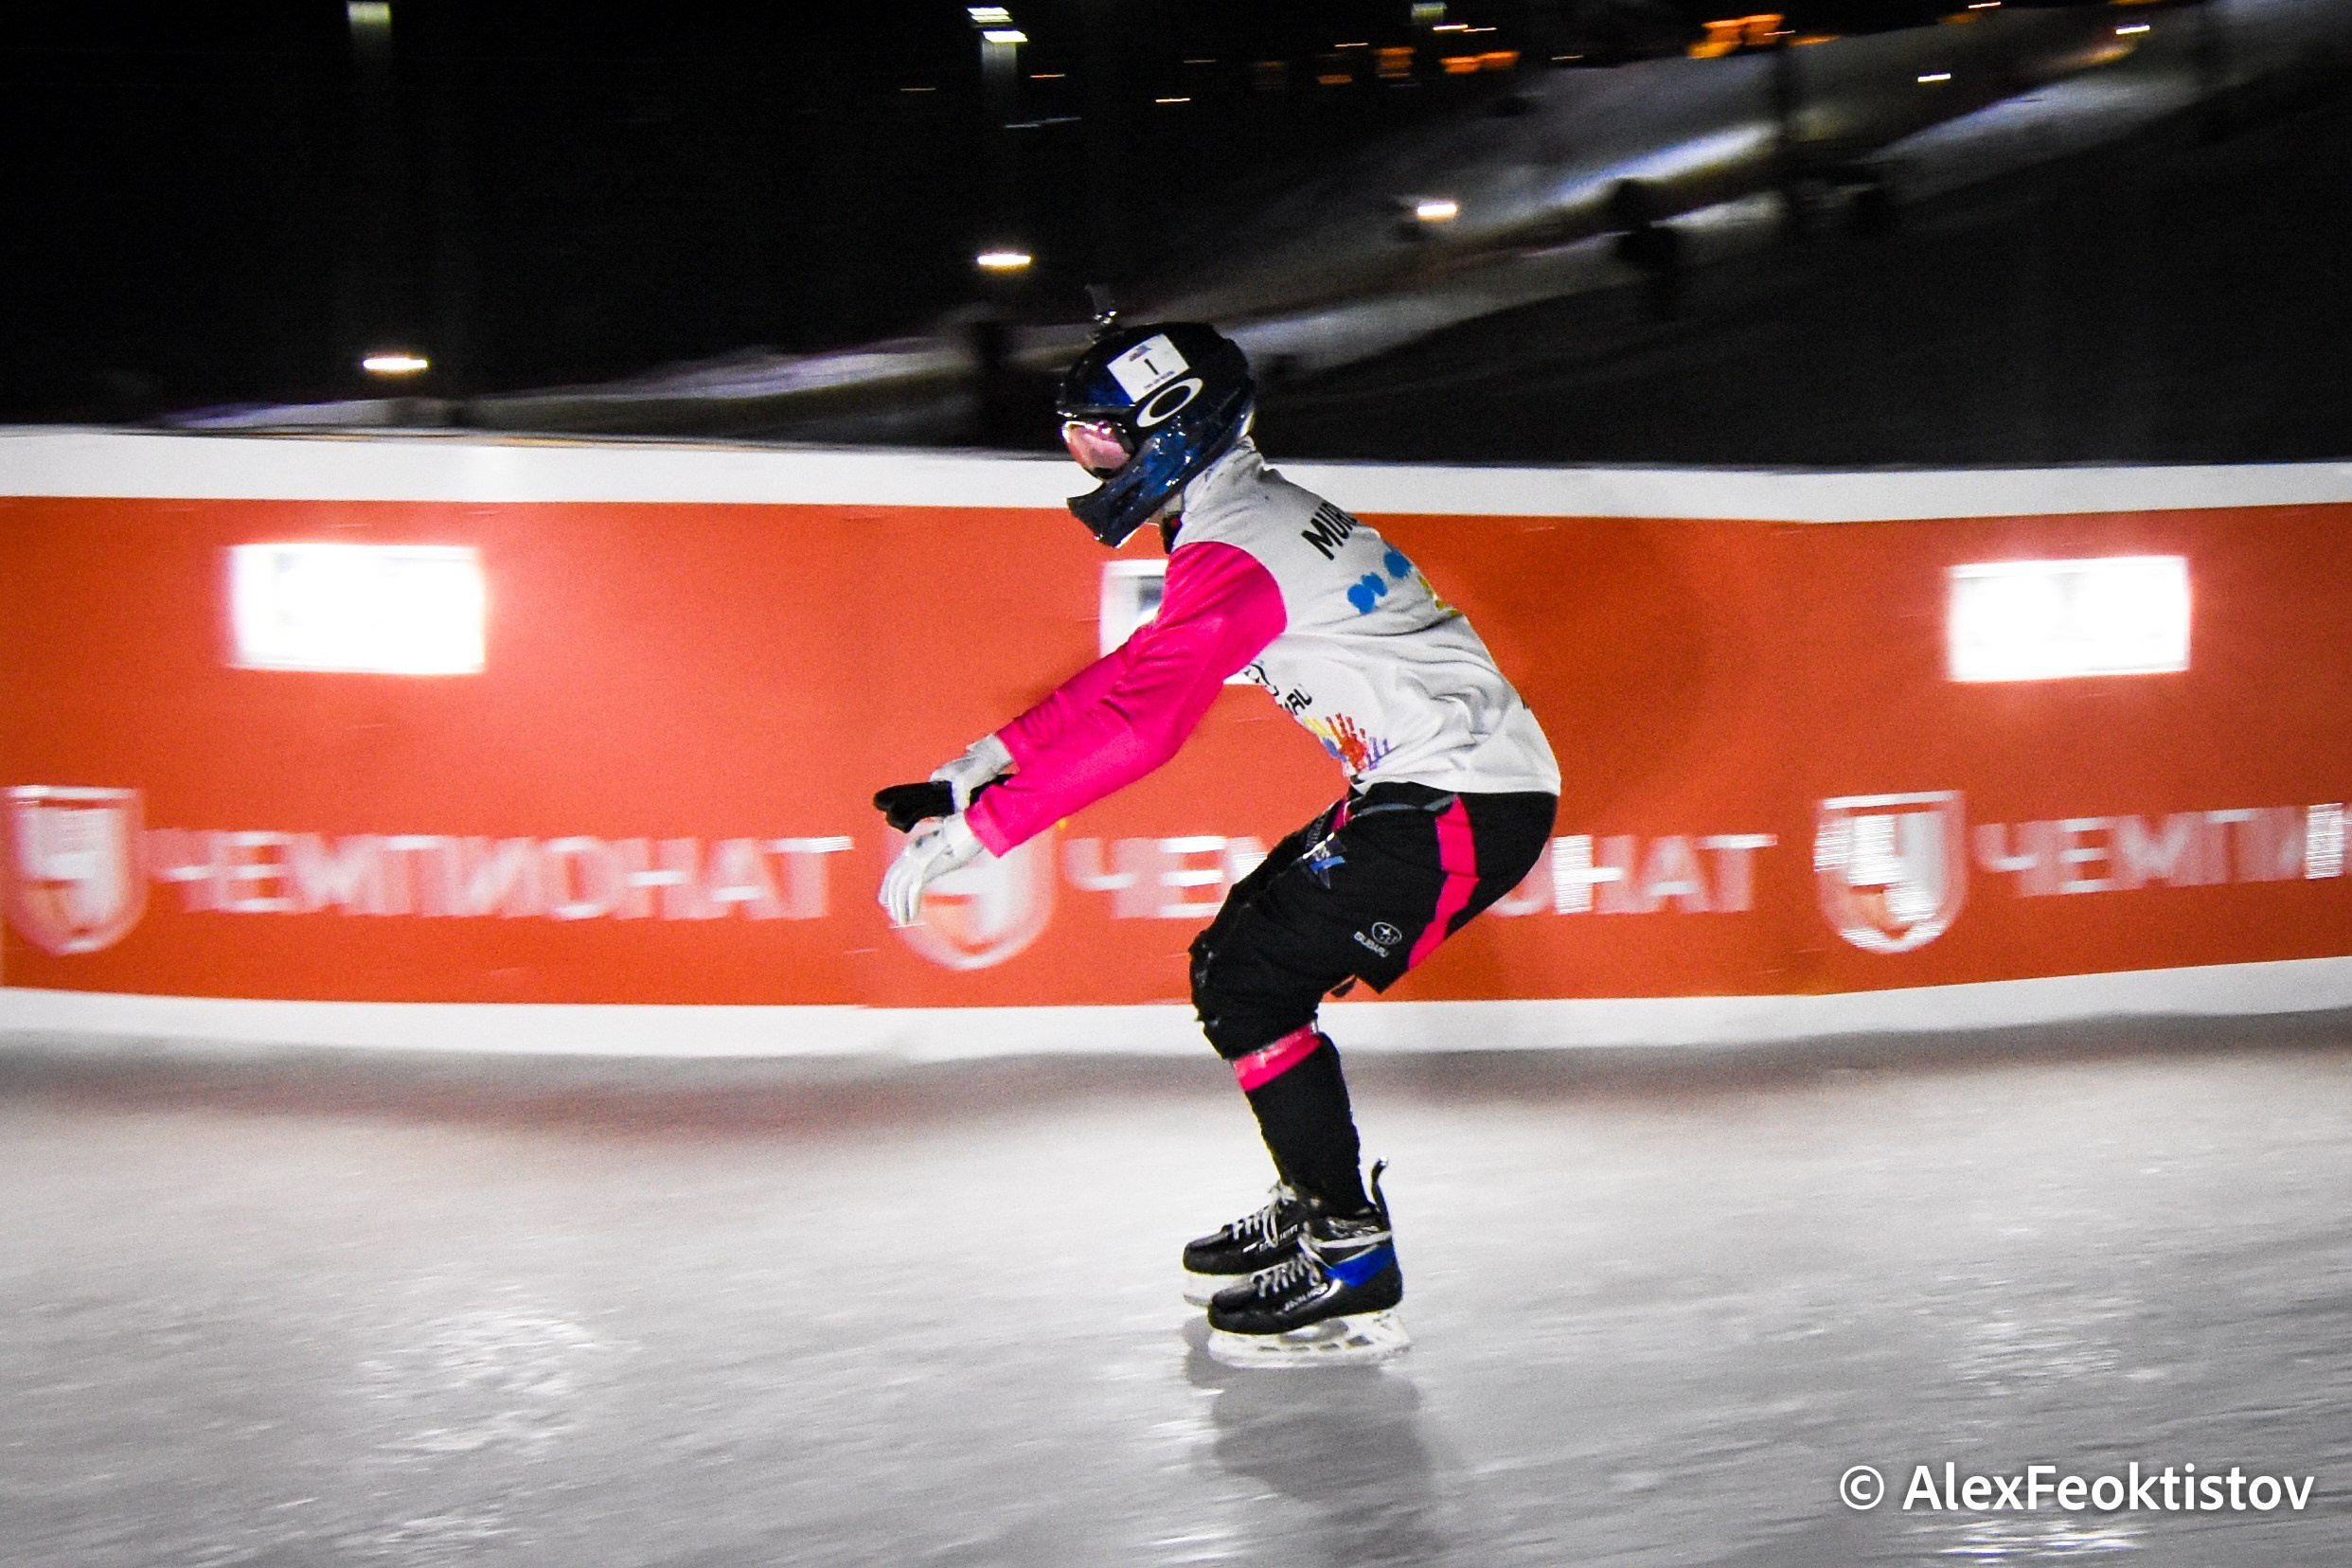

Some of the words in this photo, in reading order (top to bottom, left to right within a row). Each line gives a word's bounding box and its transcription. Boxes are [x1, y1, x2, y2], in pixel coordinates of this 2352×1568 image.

[1143, 358, 1160, 376] 1
[142, 828, 852, 920] ЧЕМПИОНАТ
[1975, 803, 2352, 897] ЧЕМПИ
